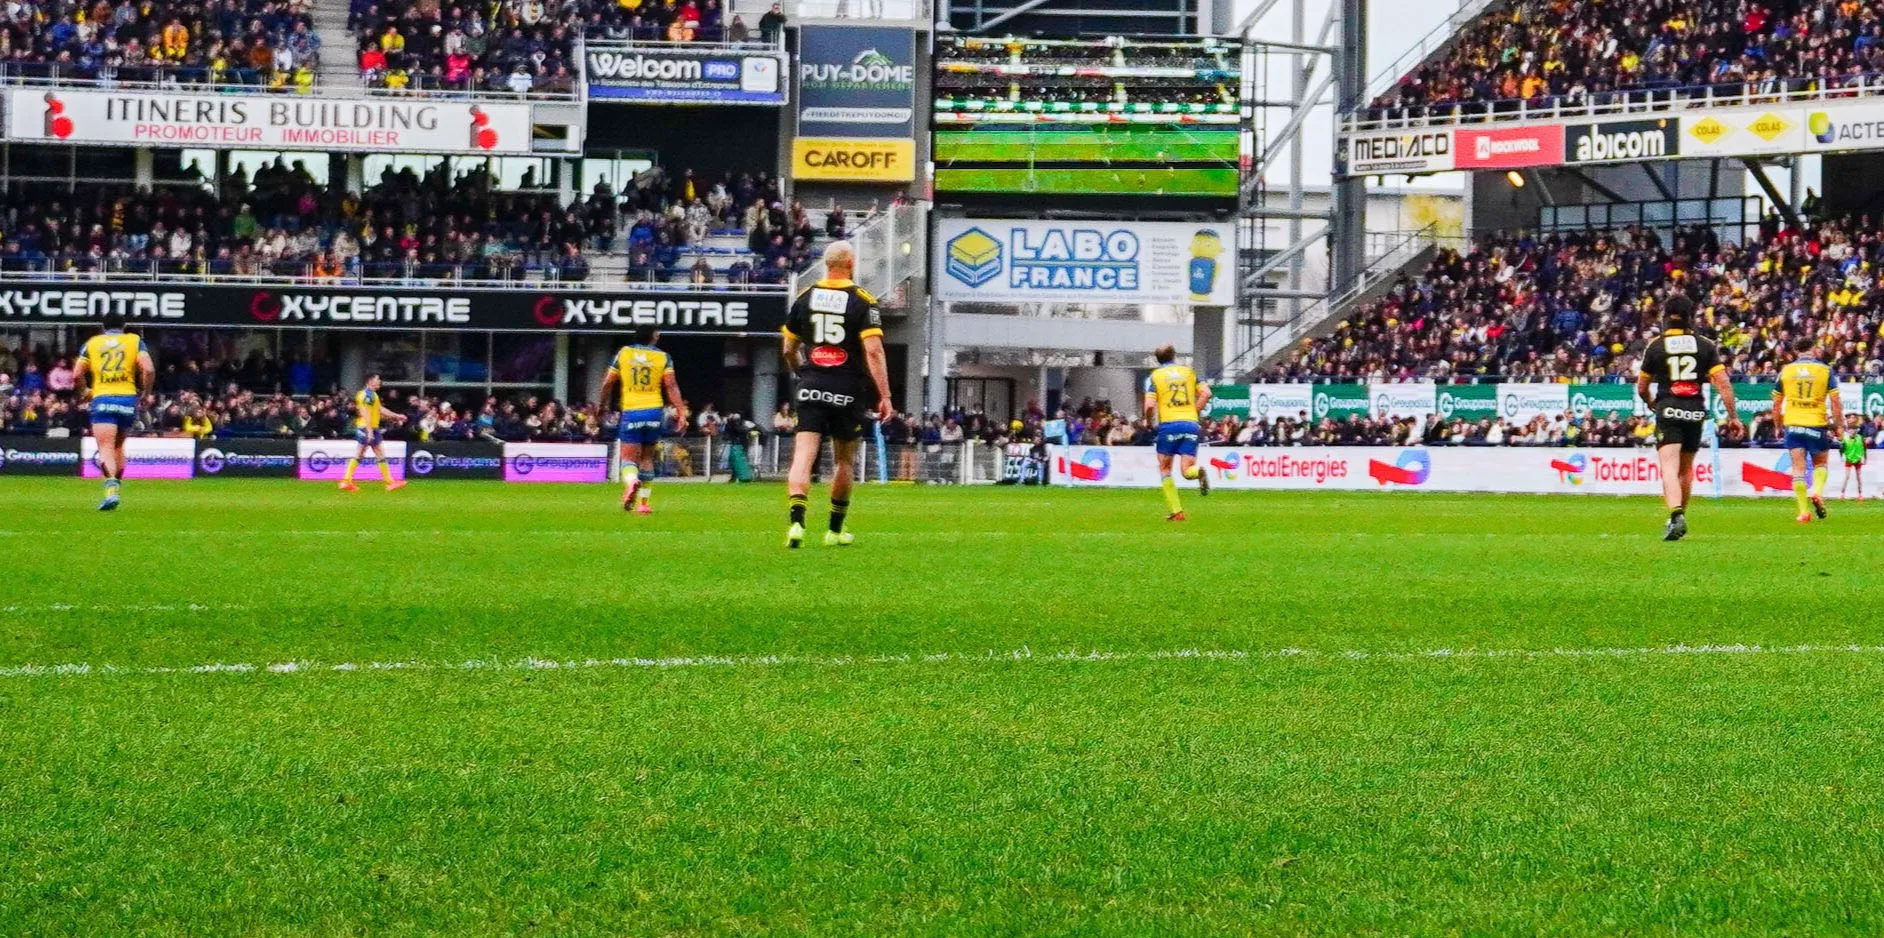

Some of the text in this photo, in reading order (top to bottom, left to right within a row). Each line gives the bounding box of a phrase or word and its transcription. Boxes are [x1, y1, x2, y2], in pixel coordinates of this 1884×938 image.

[589, 53, 737, 79] Welcom PRO
[106, 97, 438, 130] ITINERIS BUILDING
[134, 123, 399, 146] PROMOTEUR IMMOBILIER
[1576, 124, 1665, 161] abicom
[805, 150, 898, 169] CAROFF
[1010, 228, 1140, 261] LABO
[1010, 265, 1140, 290] FRANCE
[810, 313, 846, 344] 15
[100, 351, 126, 372] 22
[1666, 355, 1698, 381] 12
[631, 366, 651, 386] 13
[797, 388, 855, 406] COGEP
[1169, 384, 1190, 403] 21
[1796, 380, 1813, 399] 17
[1519, 395, 1565, 412] Groupama
[1587, 396, 1634, 411] Groupama
[226, 451, 295, 467] Groupama
[436, 454, 500, 470] Groupama
[536, 456, 600, 471] Groupama
[1244, 454, 1348, 483] TotalEnergies
